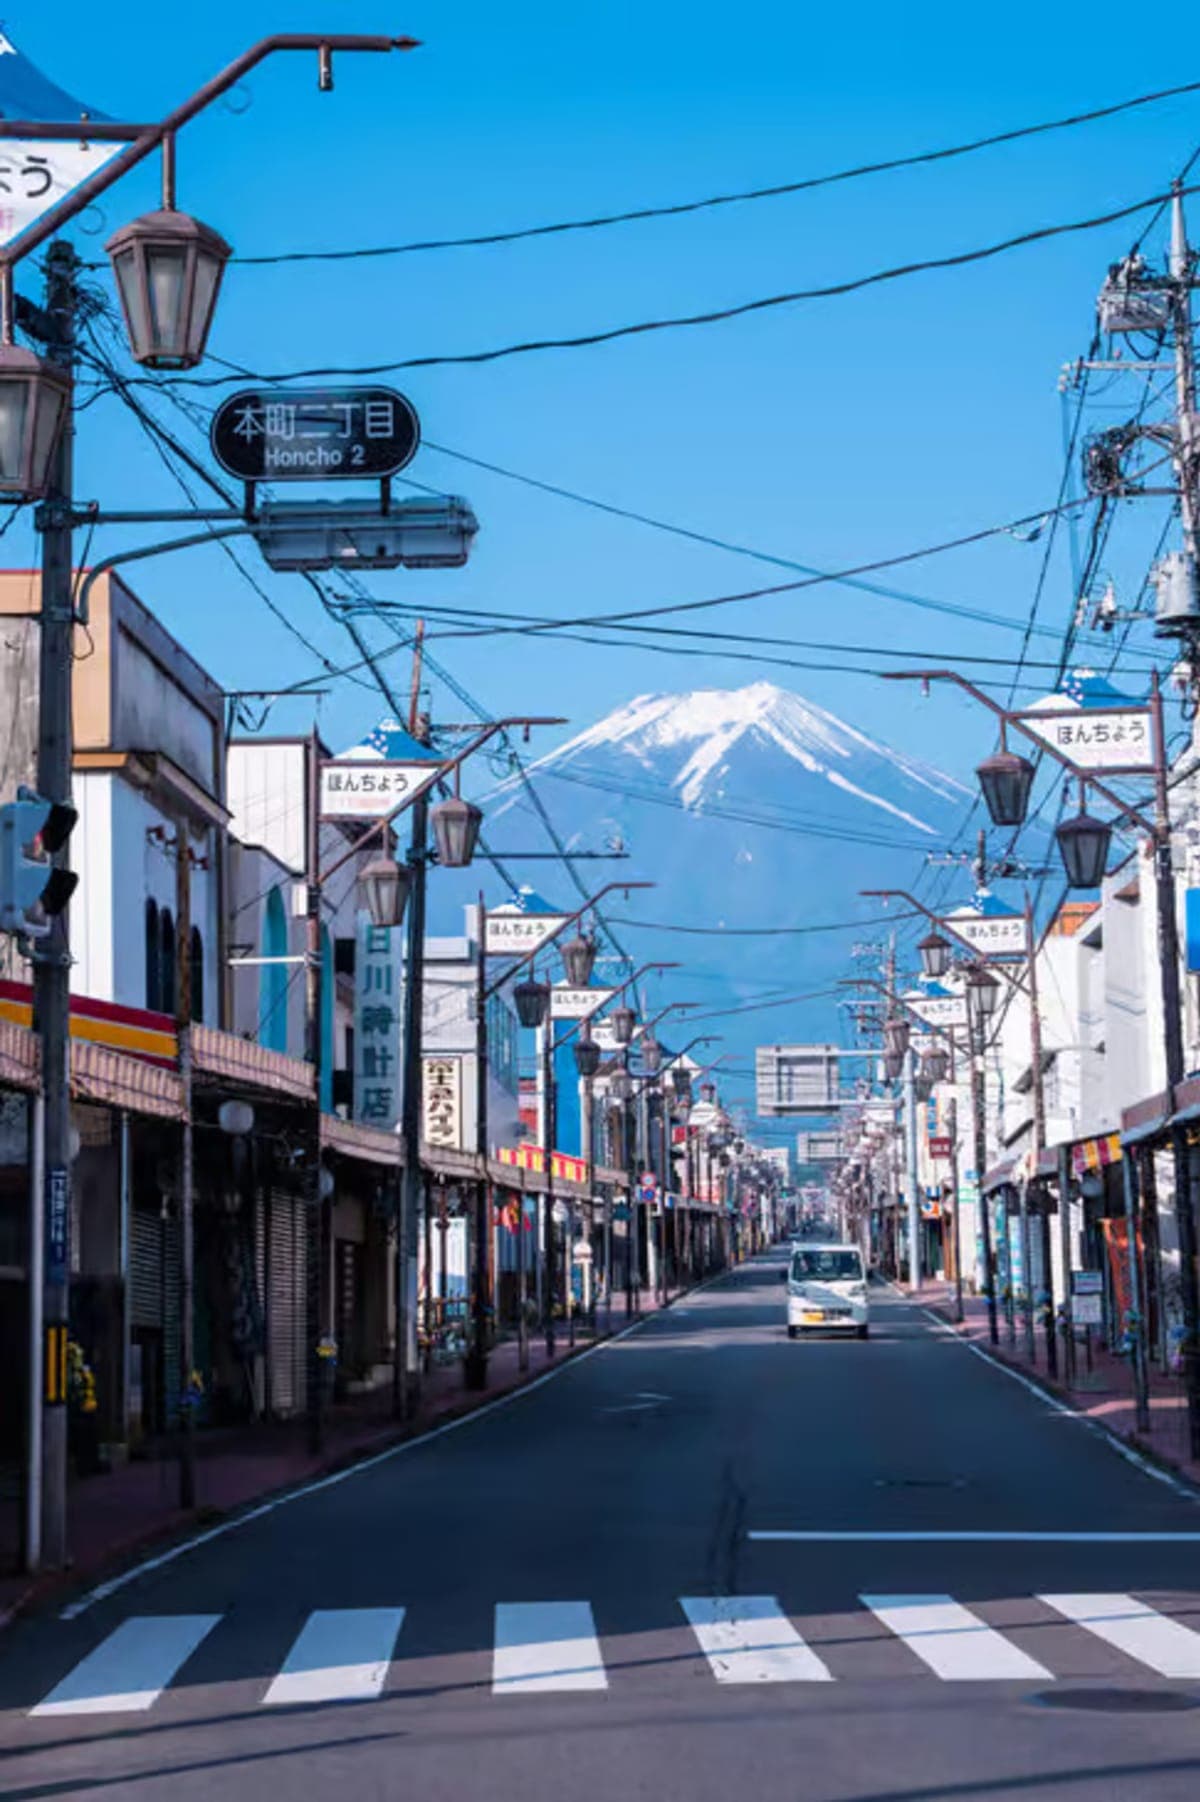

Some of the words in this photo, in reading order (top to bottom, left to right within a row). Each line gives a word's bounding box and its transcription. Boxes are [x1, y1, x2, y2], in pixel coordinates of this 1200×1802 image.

[233, 401, 394, 444] 本町二丁目
[264, 446, 343, 467] Honcho
[351, 445, 366, 465] 2
[1057, 720, 1145, 745] ほんちょう
[327, 773, 409, 793] ほんちょう
[489, 922, 547, 936] ほんちょう
[965, 923, 1021, 937] ほんちょう
